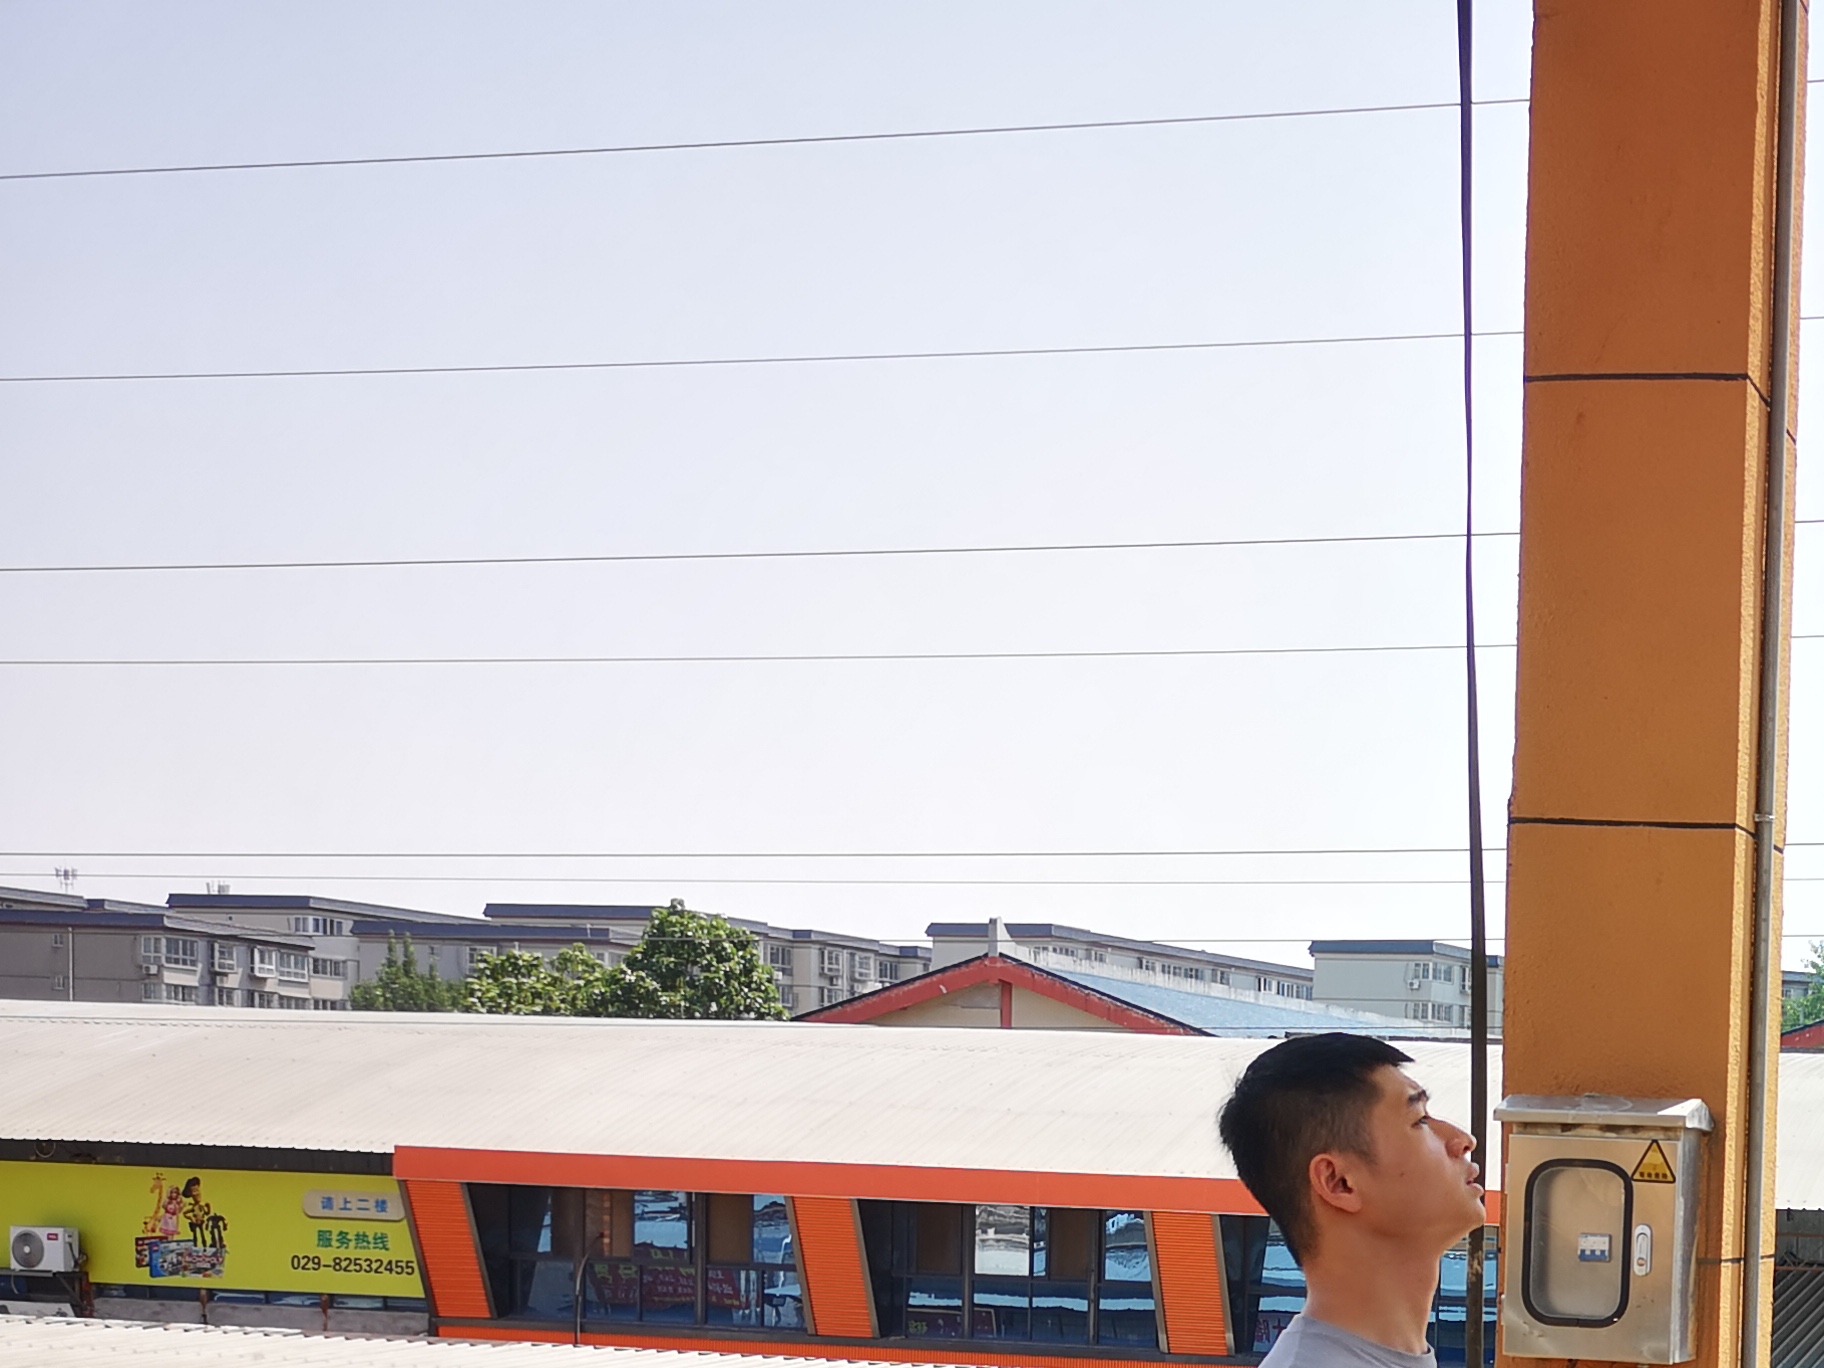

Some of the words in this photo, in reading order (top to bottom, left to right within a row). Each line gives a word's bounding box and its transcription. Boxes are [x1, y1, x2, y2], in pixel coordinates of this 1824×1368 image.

[320, 1196, 389, 1214] 请上二楼
[316, 1229, 390, 1251] 服务热线
[291, 1255, 415, 1276] 029-82532455
